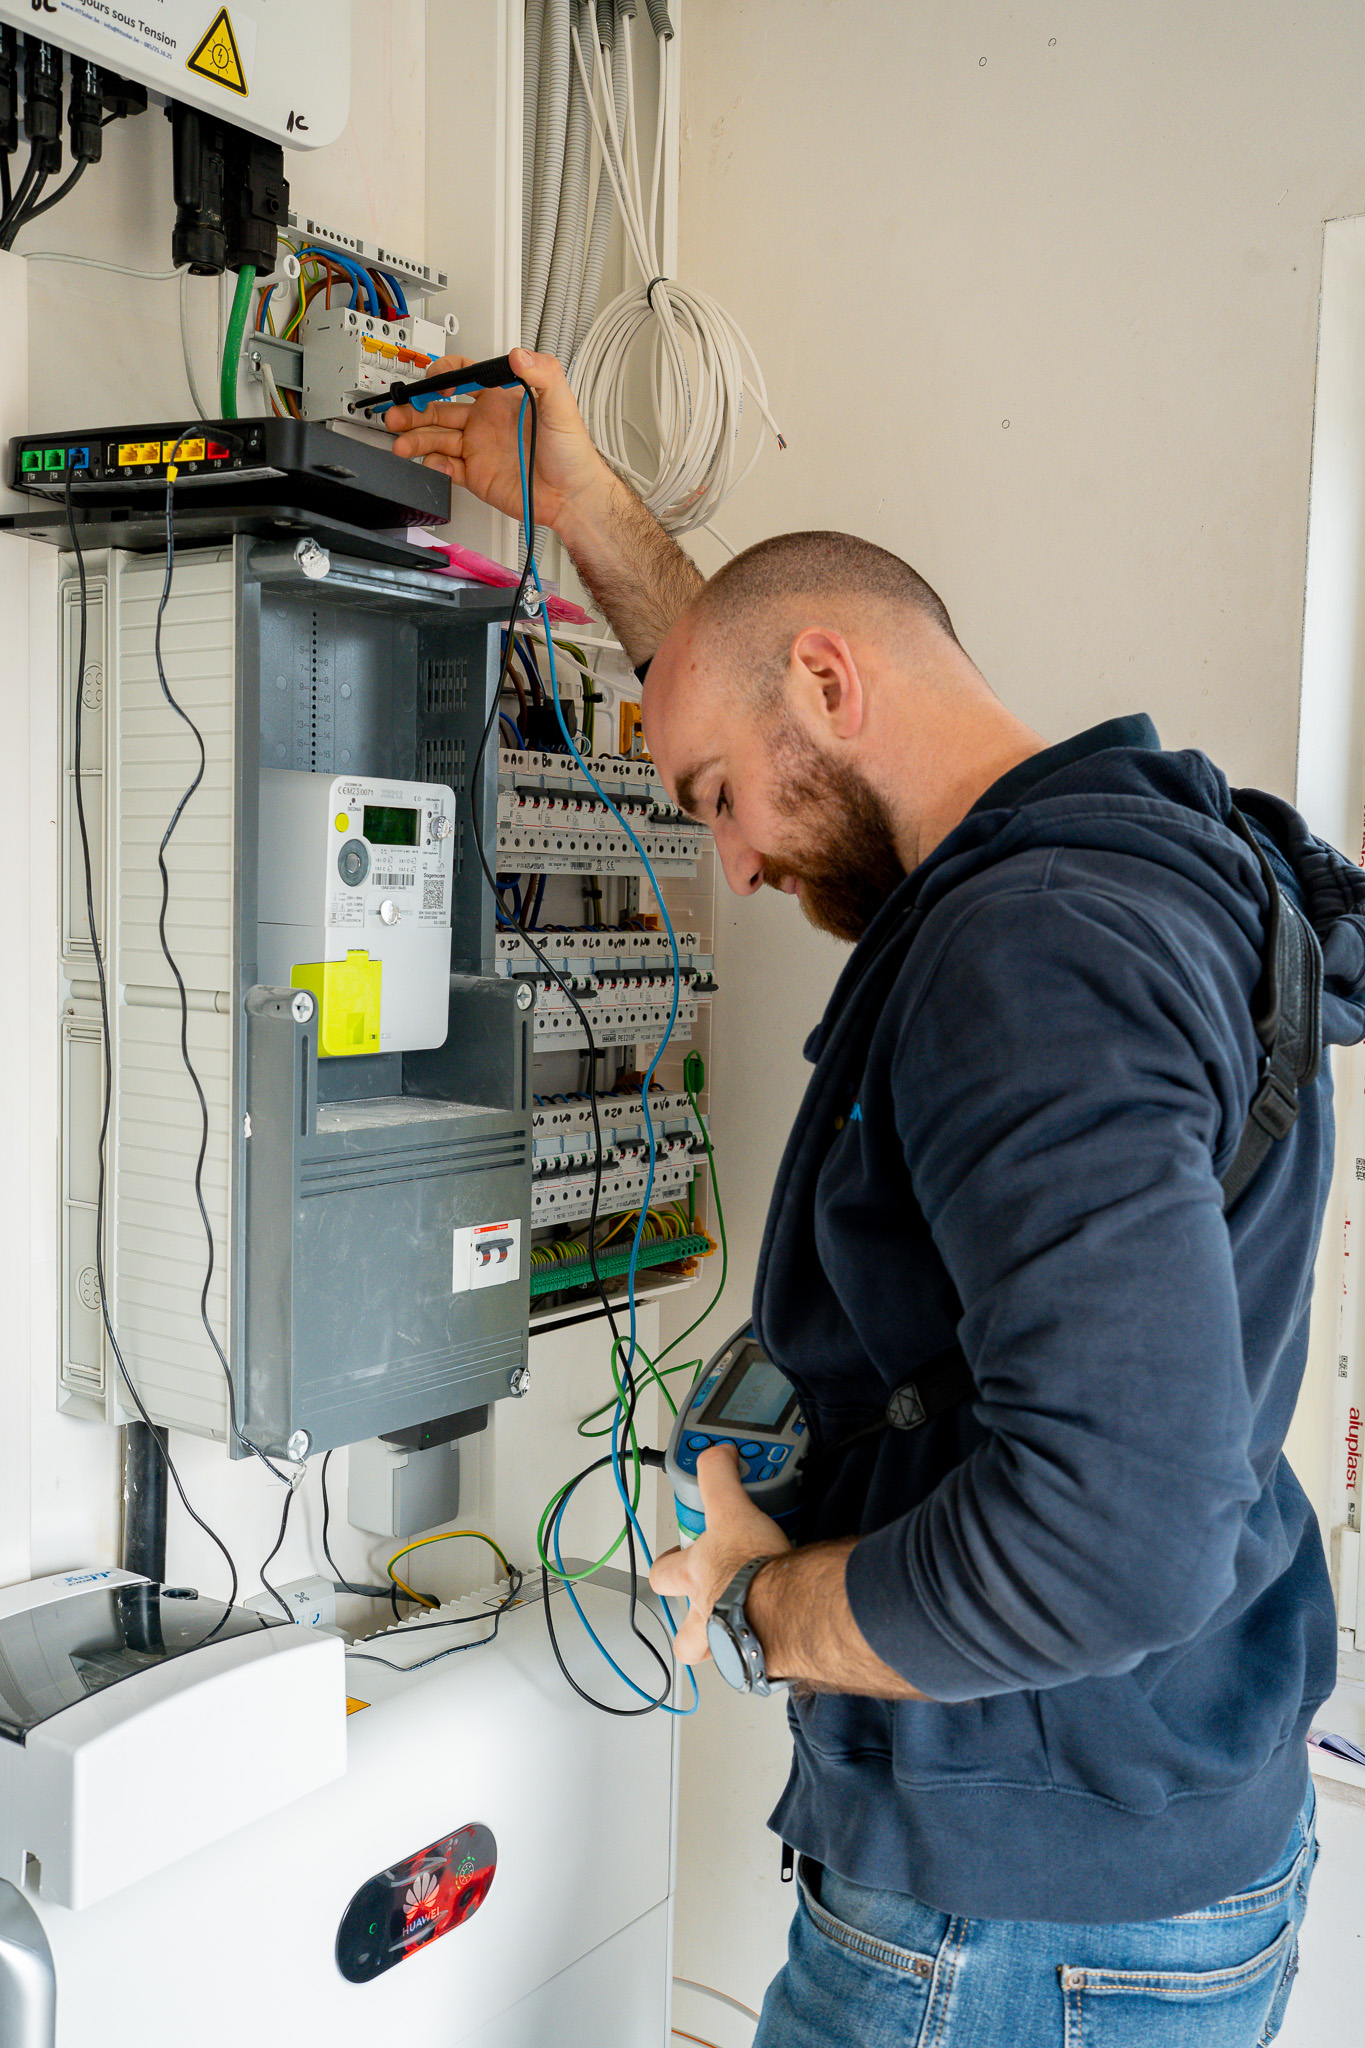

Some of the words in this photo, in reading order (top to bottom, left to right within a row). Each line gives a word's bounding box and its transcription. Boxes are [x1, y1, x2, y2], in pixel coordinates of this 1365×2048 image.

[111, 10, 136, 28] sous
[138, 19, 177, 49] Tension
[1345, 1407, 1363, 1491] aluplast
[402, 1906, 440, 1937] HUAWEI
